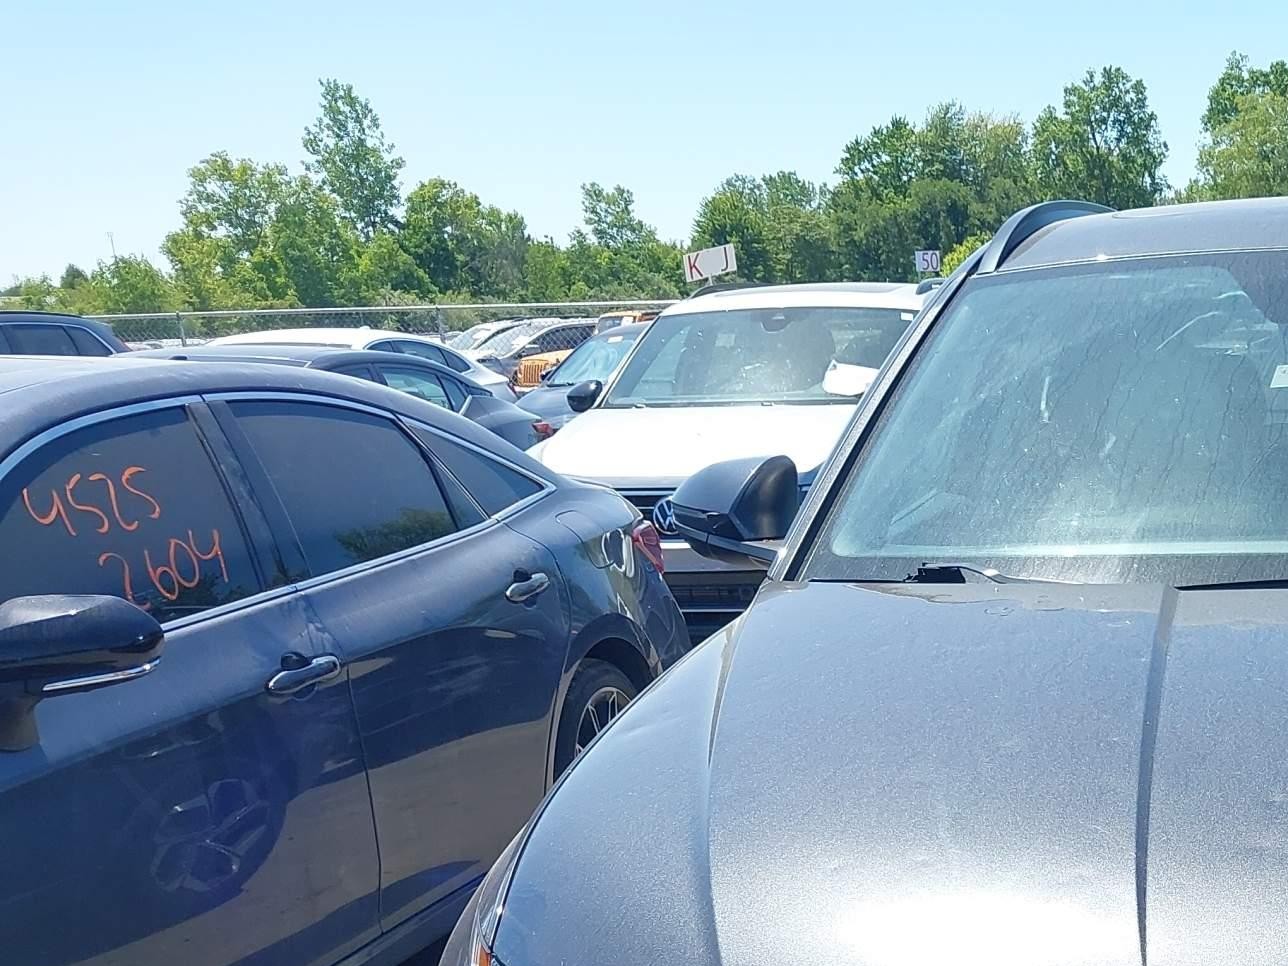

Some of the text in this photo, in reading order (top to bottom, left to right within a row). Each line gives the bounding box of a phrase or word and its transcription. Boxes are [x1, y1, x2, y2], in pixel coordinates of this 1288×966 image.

[688, 246, 729, 280] K J
[922, 252, 939, 270] 50
[22, 466, 161, 536] 4525
[98, 529, 229, 610] 2604
